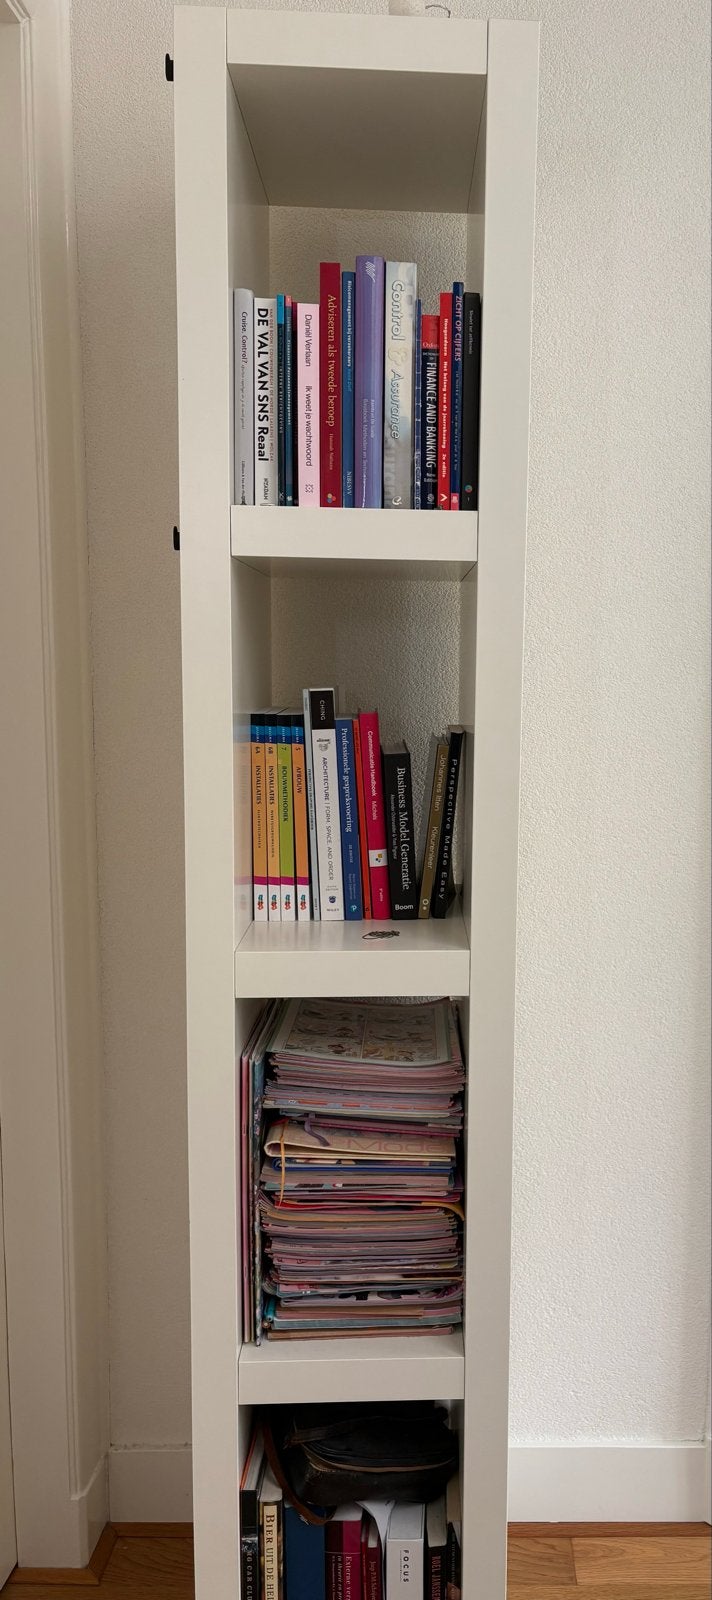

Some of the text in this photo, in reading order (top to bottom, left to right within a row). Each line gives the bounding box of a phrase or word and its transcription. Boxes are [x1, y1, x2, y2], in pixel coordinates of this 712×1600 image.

[391, 280, 406, 341] Control
[455, 320, 462, 332] OP
[326, 294, 337, 427] Adviseren als tweede beroep
[387, 346, 410, 366] &
[453, 333, 462, 362] CIJFERS
[258, 308, 269, 462] DE VAL VAN SNS Reaal
[305, 385, 312, 393] Ik
[390, 369, 406, 440] Assurance
[304, 412, 313, 420] je
[426, 362, 437, 468] FINANCE AND BANKING
[442, 404, 448, 412] de
[305, 420, 313, 467] wachtwoord
[341, 727, 350, 775] Professionele
[367, 730, 376, 768] Communicatie
[322, 757, 330, 801] ARCHITECTURE
[370, 769, 378, 797] Handboek
[434, 754, 447, 812] Johannes Itten
[343, 775, 353, 833] gespreksvoering
[396, 767, 412, 890] Business Model Generatie
[427, 826, 439, 869] Kleurenleer
[438, 758, 458, 900] Perspective Made Easy
[265, 1547, 274, 1565] UIT
[266, 1567, 274, 1581] DE
[431, 1555, 442, 1573] ROEL
